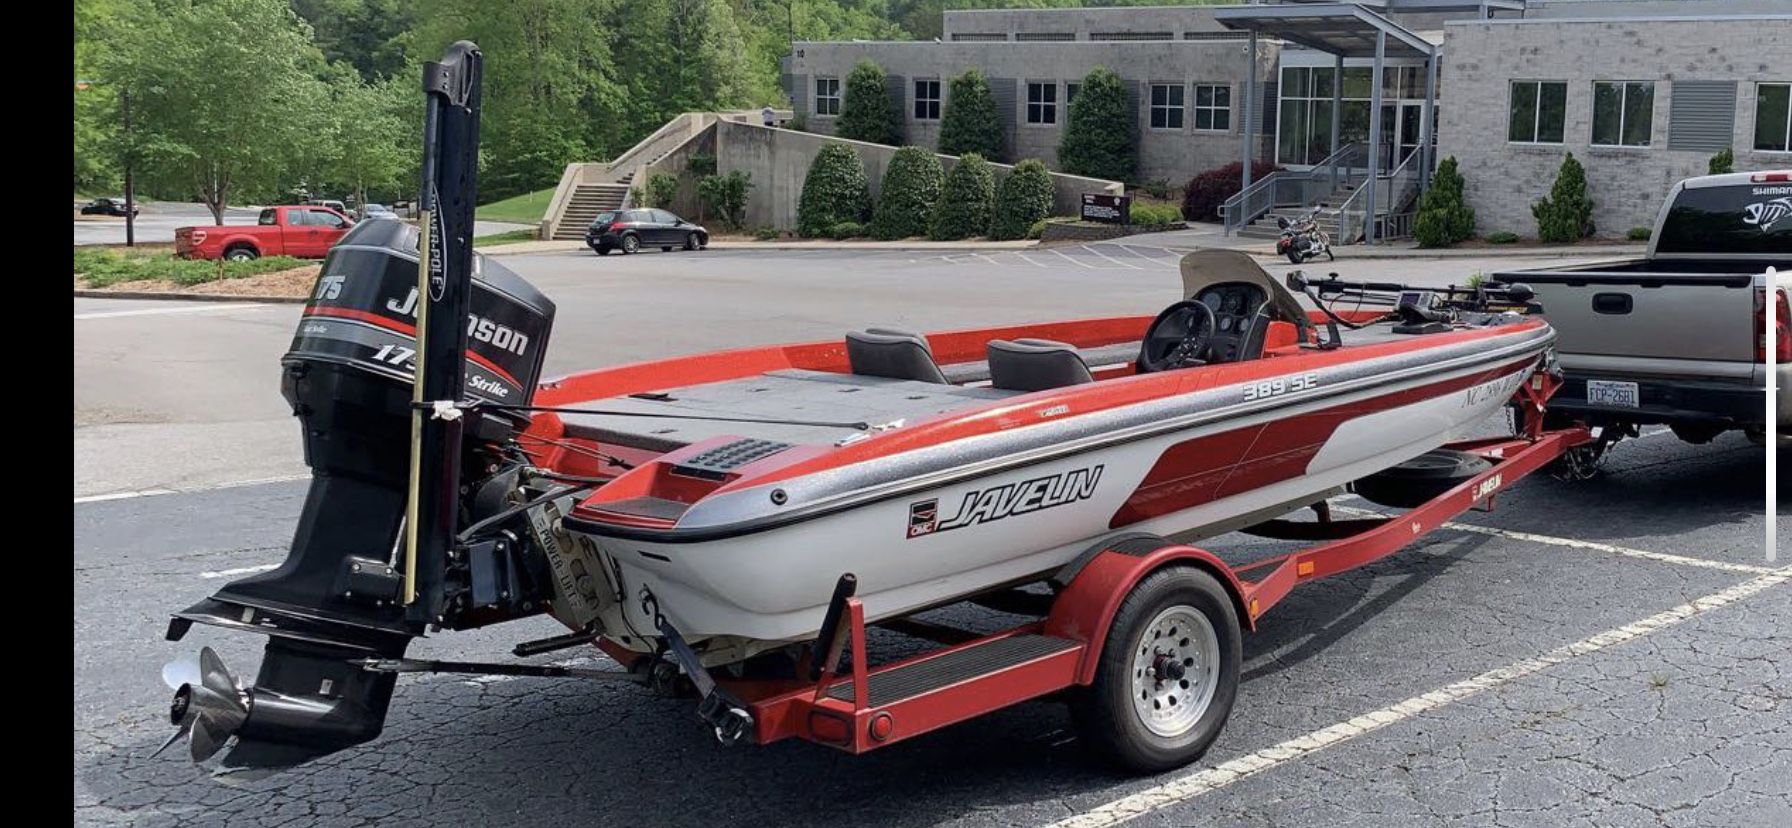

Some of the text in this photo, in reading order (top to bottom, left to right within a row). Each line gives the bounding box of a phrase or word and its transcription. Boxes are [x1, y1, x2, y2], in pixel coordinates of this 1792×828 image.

[796, 49, 805, 58] 10
[468, 375, 509, 398] Strike
[1243, 372, 1318, 401] 389 SE
[936, 464, 1105, 533] JAVELIN
[910, 523, 934, 537] OMC
